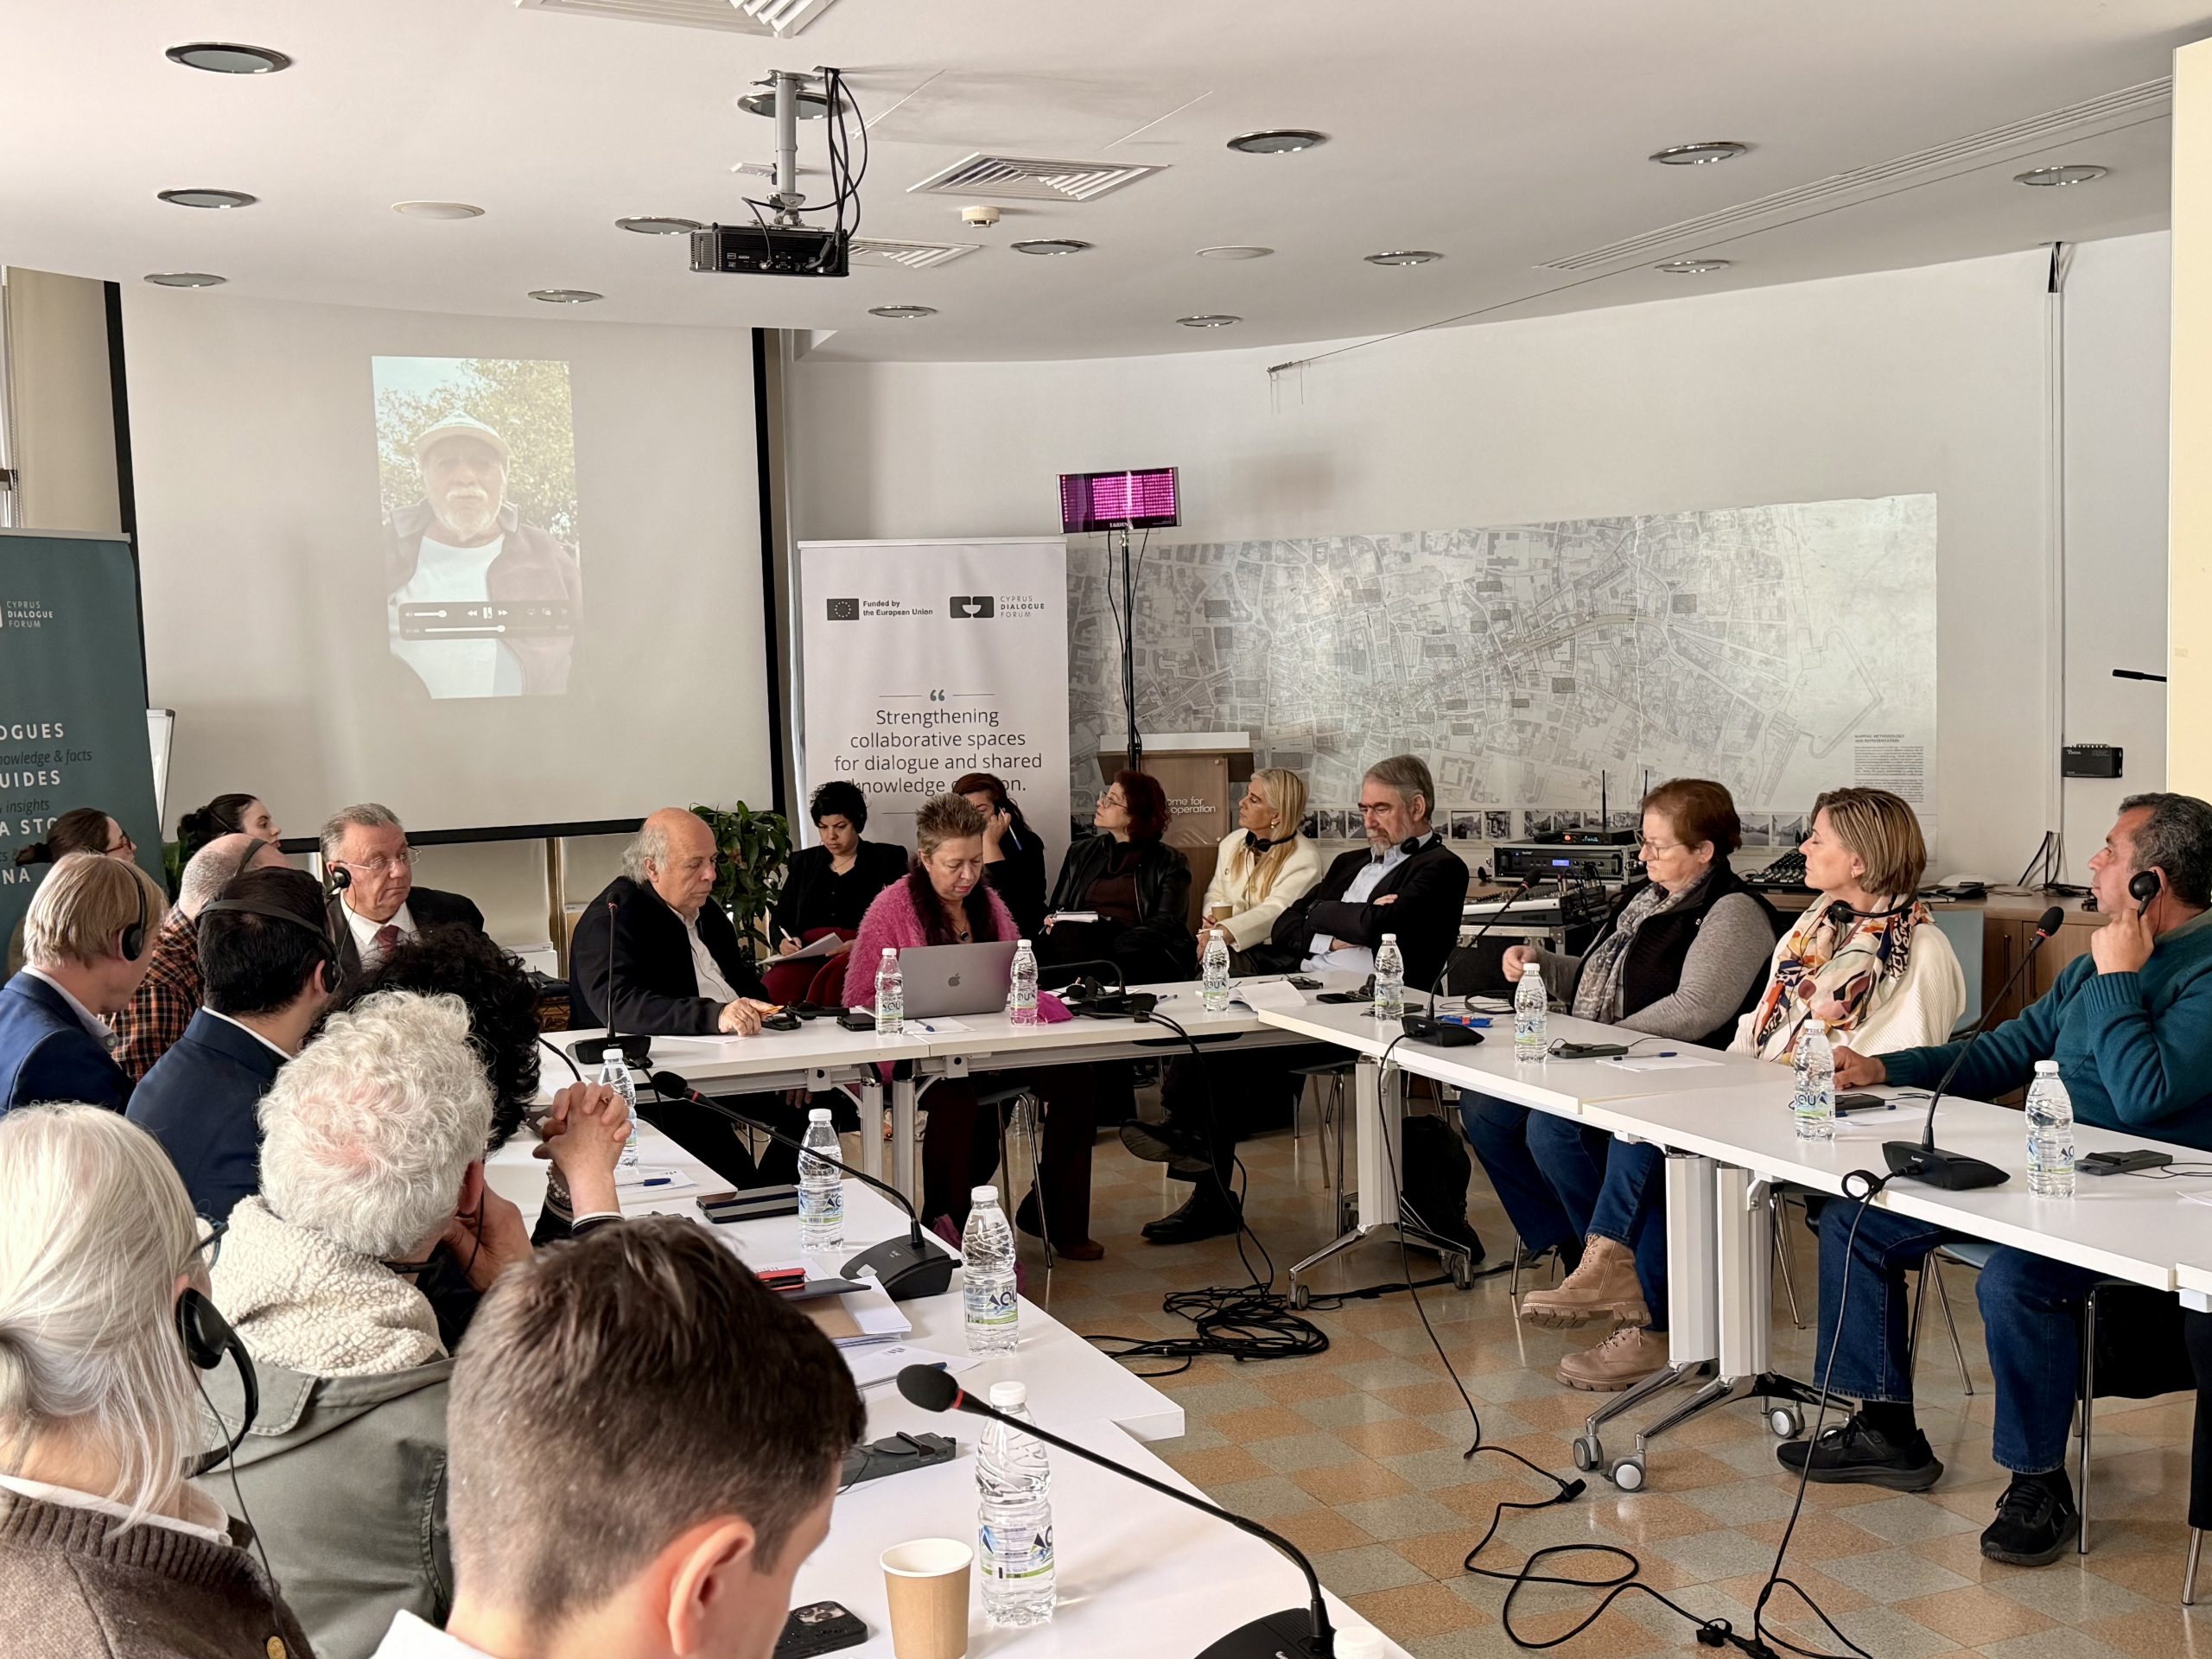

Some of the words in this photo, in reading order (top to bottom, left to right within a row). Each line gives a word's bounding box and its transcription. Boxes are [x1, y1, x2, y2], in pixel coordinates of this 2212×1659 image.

[6, 601, 41, 609] CYPRUS
[7, 610, 54, 619] DIALOGUE
[876, 608, 911, 617] European
[9, 620, 41, 628] FORUM
[876, 709, 999, 728] Strengthening
[850, 732, 962, 749] collaborative
[967, 732, 1027, 751] spaces
[0, 750, 50, 767] owledge
[54, 749, 63, 762] &
[65, 749, 92, 766] facts
[835, 755, 860, 771] for
[865, 754, 939, 774] dialogue
[944, 753, 976, 769] and
[982, 753, 1042, 768] shared
[6, 798, 50, 815] insights
[1191, 796, 1205, 805] for
